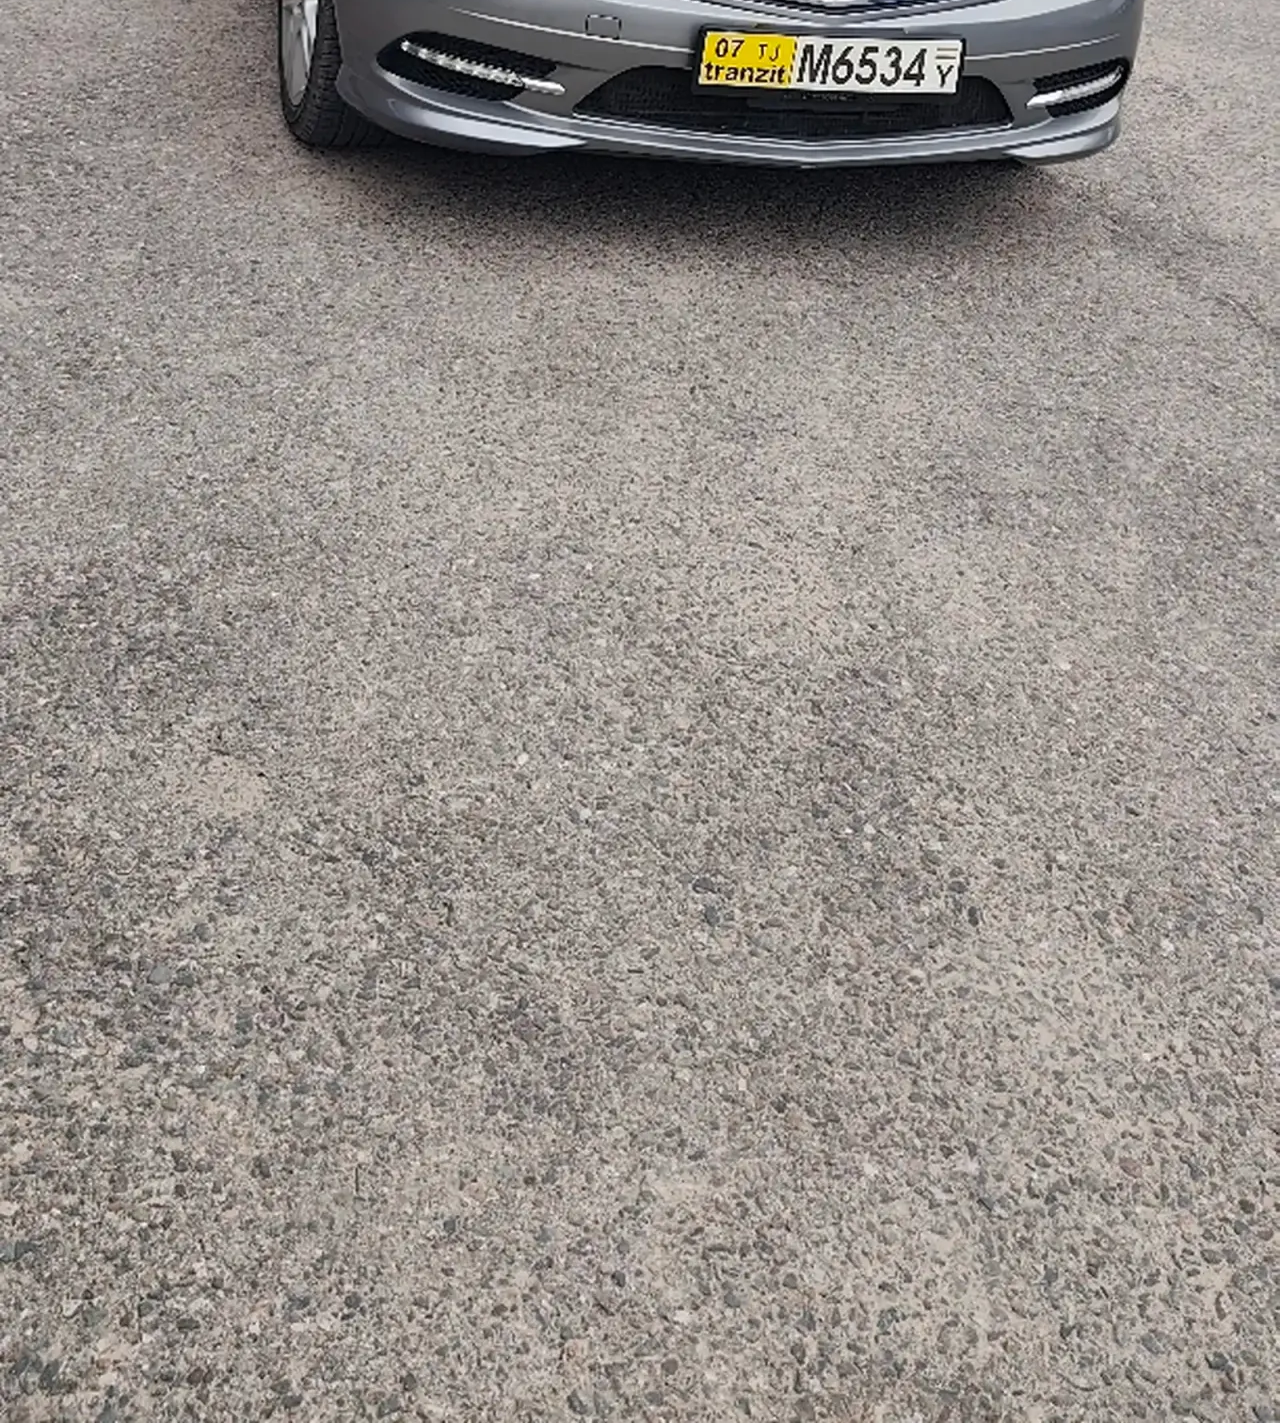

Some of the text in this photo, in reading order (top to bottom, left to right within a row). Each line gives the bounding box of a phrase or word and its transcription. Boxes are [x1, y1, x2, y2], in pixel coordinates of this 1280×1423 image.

[715, 37, 781, 62] 07 TJ
[703, 61, 786, 84] tranzit
[796, 43, 927, 87] M6534
